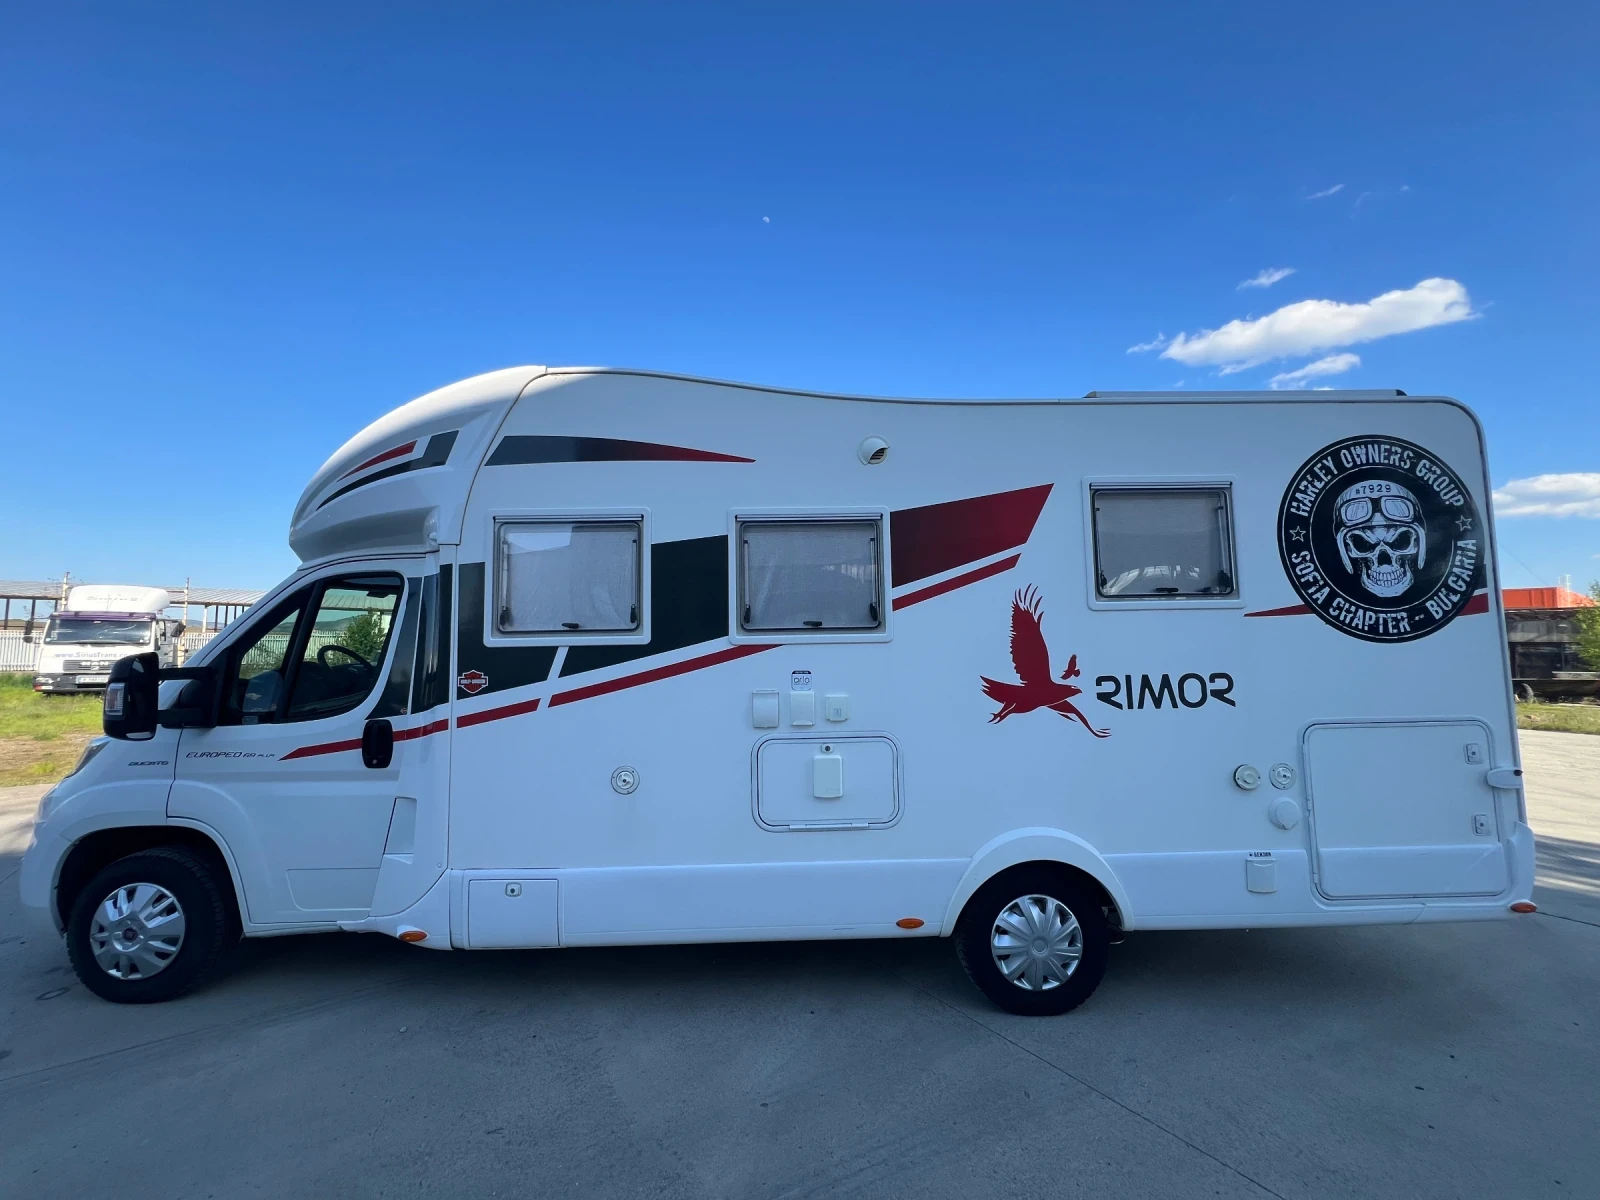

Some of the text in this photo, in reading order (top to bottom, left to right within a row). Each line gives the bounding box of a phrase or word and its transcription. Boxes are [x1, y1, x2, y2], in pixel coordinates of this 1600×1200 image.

[1290, 443, 1464, 517] HARLEY OWNERS GROUP
[1355, 483, 1392, 495] #7929
[1291, 550, 1331, 605] SOFIA
[1328, 597, 1411, 634] CHAPTER
[1425, 539, 1477, 620] BULGARIA
[1095, 672, 1236, 711] RIMOR
[185, 751, 243, 759] EUROPEO
